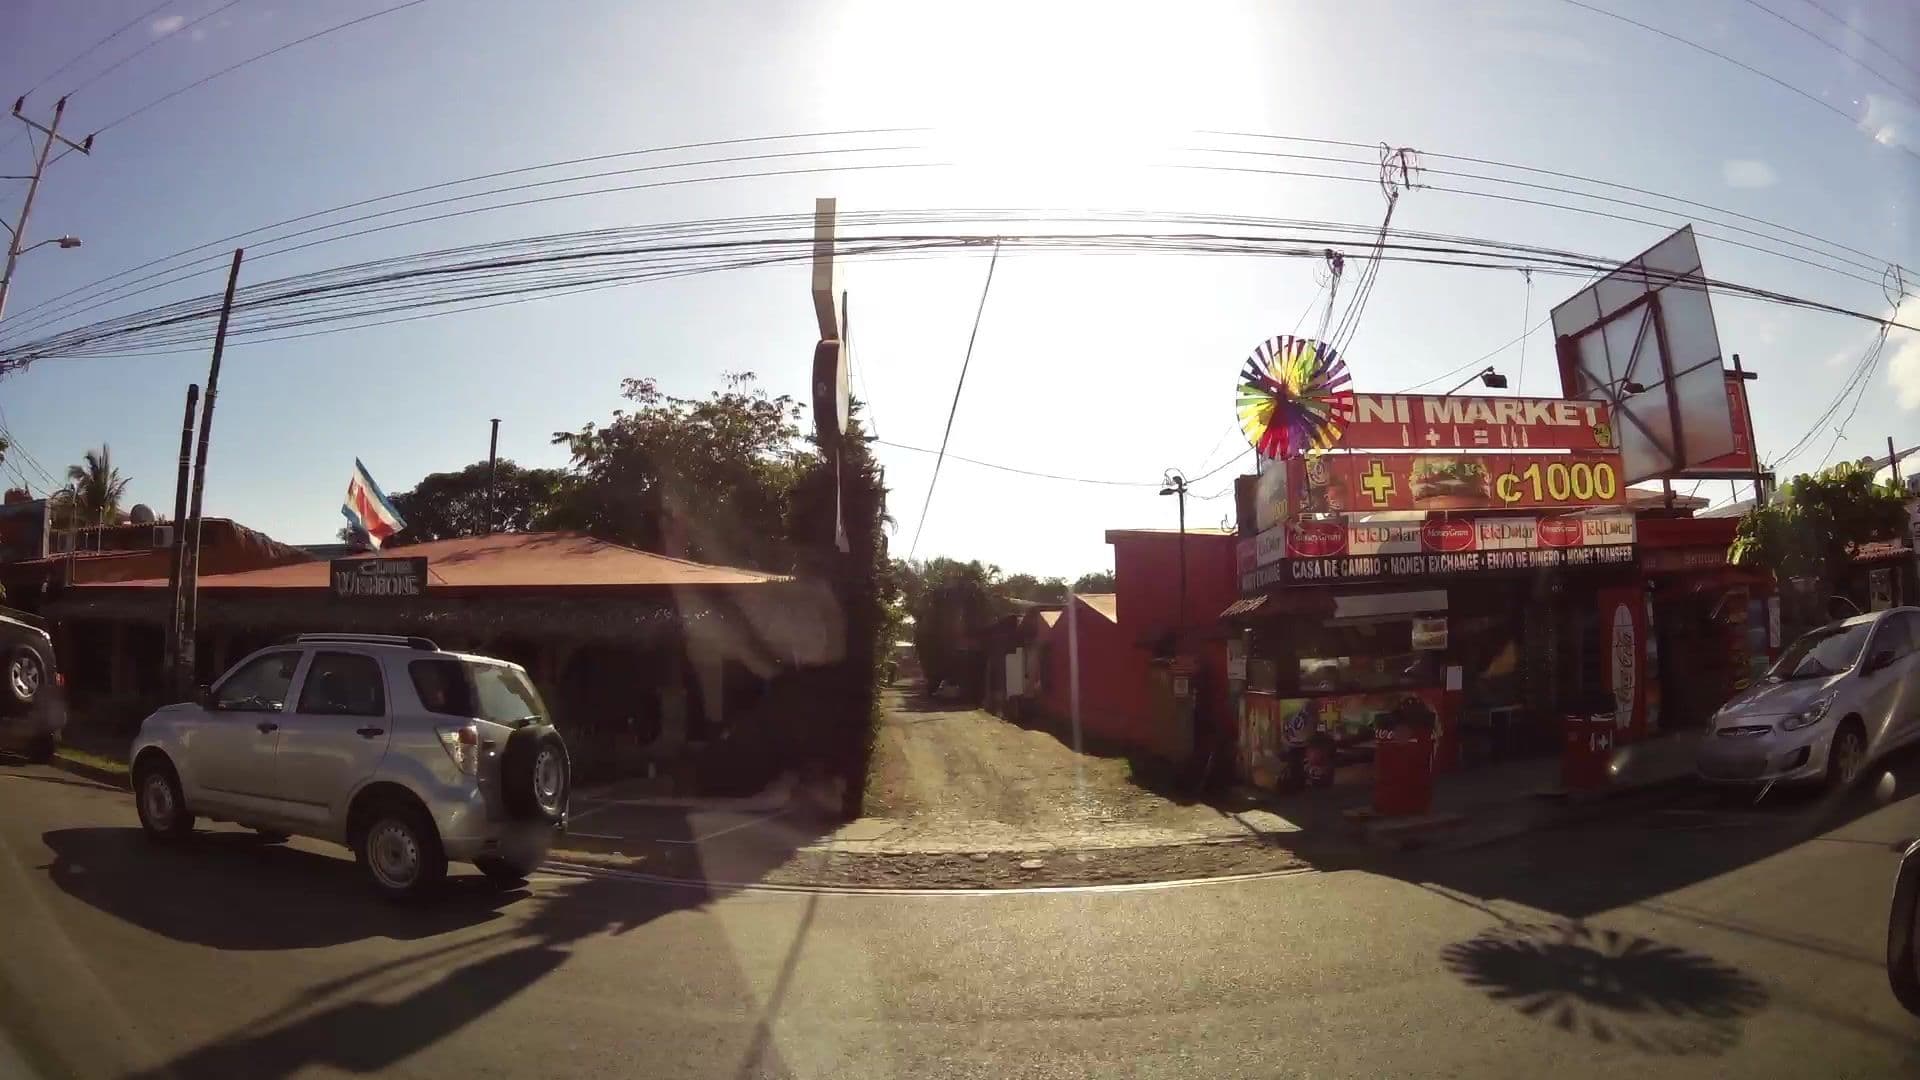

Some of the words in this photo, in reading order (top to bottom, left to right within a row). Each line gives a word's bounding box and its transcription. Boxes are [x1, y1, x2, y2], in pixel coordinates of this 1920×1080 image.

[1423, 397, 1601, 427] MARKET
[1292, 560, 1321, 580] CASA
[1324, 559, 1339, 577] DE
[1341, 557, 1380, 577] CAMBIO
[1391, 555, 1425, 576] MONEY
[1428, 552, 1480, 573] EXCHANGE
[1487, 550, 1514, 570] ENVIO
[1516, 551, 1528, 568] DE
[1529, 549, 1560, 567] DINERO
[1567, 547, 1594, 565] MONEY
